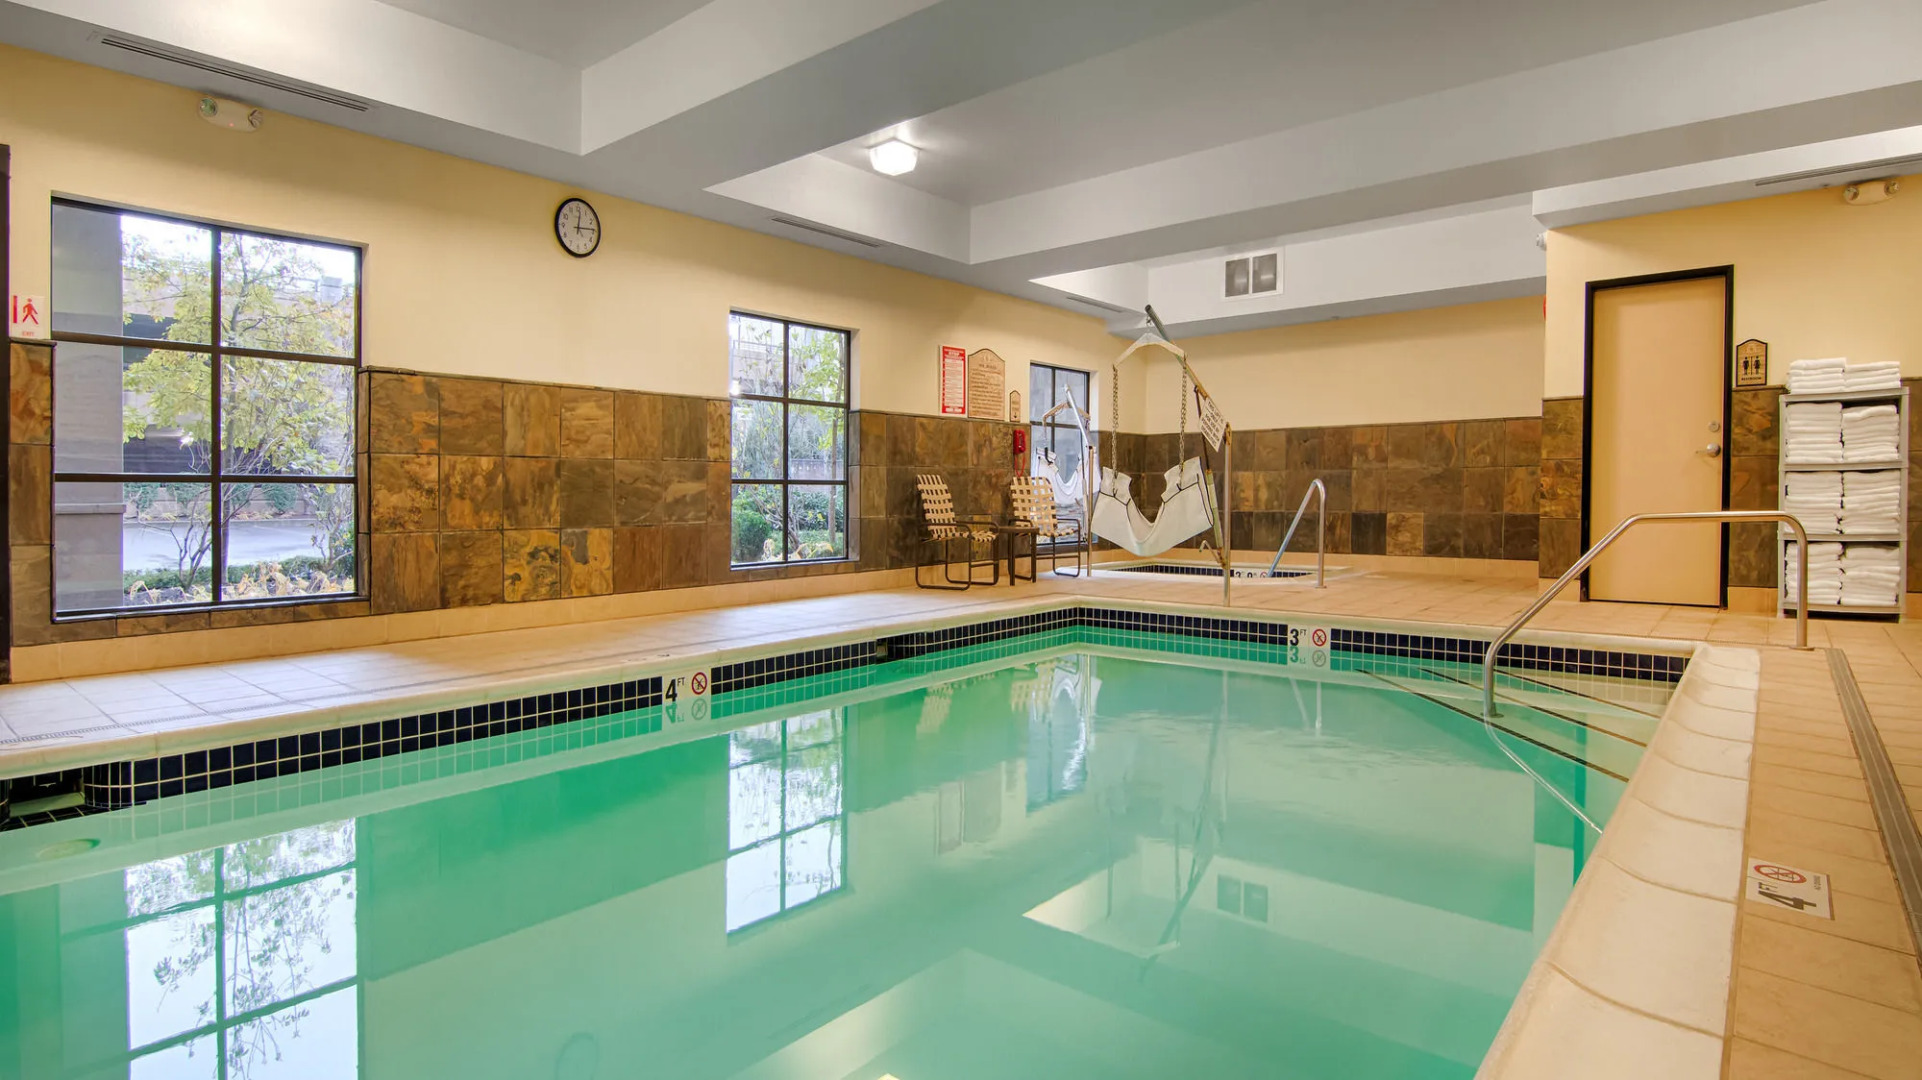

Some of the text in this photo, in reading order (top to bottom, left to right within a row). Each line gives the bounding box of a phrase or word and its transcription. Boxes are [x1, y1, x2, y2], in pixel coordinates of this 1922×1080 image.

[1290, 628, 1299, 646] 3
[666, 677, 685, 702] 4 FT
[1758, 882, 1816, 910] 4 FT
